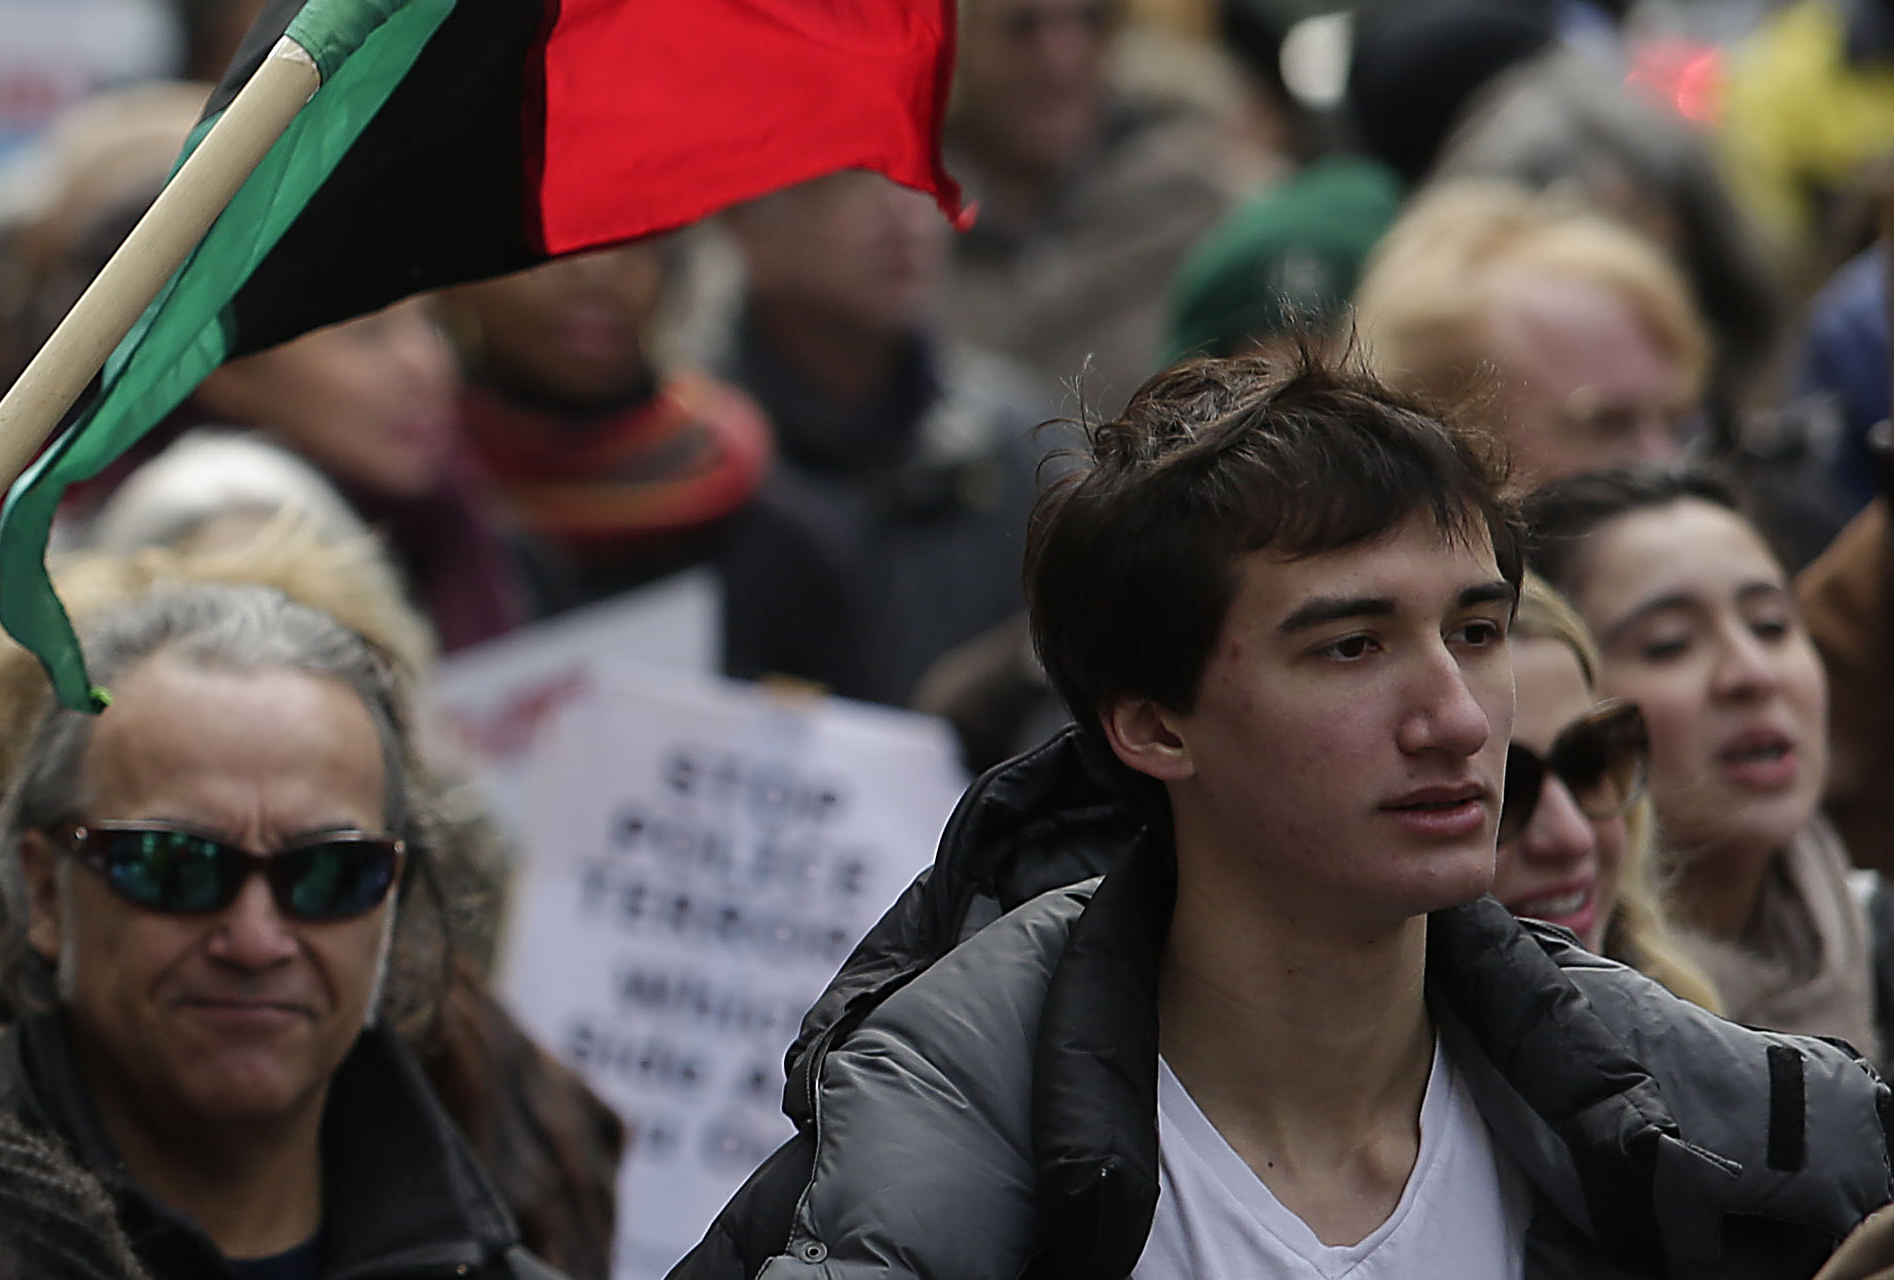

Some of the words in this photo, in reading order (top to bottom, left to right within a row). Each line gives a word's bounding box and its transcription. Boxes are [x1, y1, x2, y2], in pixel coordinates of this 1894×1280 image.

[662, 742, 852, 822] STOP
[608, 800, 874, 898] POLICE
[578, 858, 854, 962] TERROR
